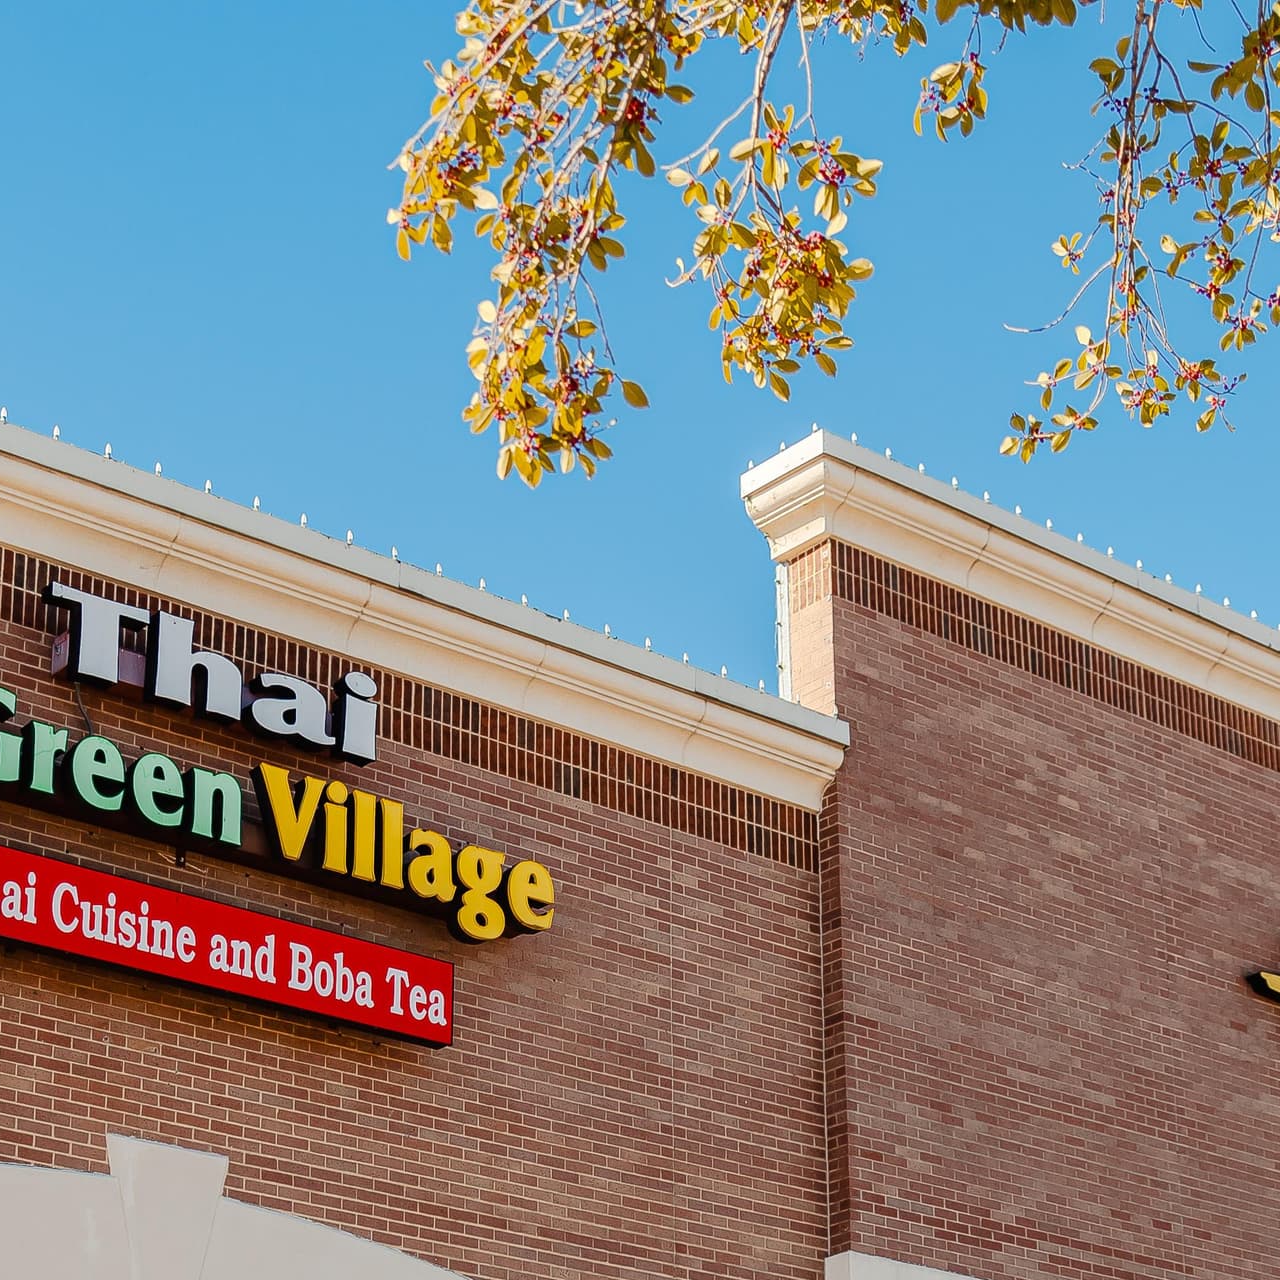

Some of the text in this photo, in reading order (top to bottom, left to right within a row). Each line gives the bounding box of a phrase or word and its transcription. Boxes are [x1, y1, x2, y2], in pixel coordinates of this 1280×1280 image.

[48, 580, 379, 764] Thai
[253, 761, 556, 941] Village
[51, 881, 197, 964] Cuisine
[208, 926, 278, 985] and
[288, 941, 375, 1009] Boba
[385, 967, 448, 1028] Tea
